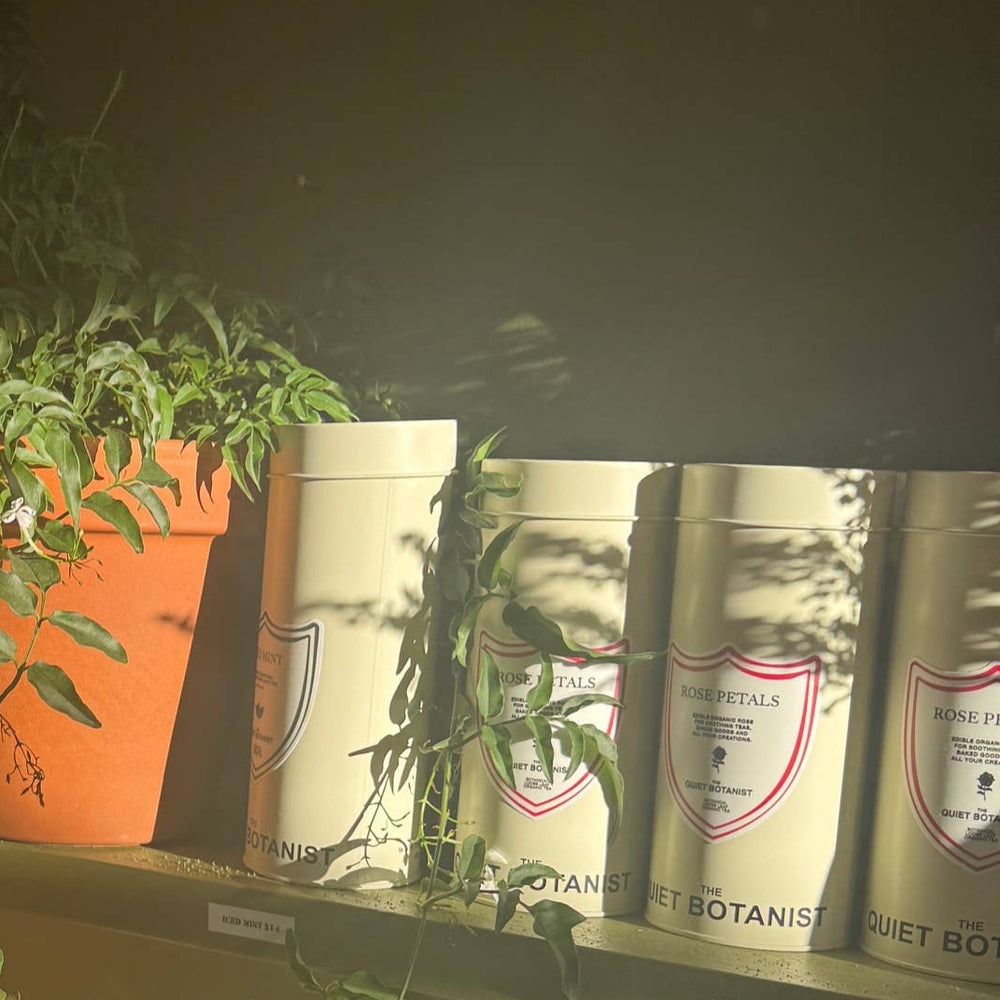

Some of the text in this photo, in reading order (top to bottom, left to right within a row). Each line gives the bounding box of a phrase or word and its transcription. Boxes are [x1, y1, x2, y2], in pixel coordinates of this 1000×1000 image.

[681, 684, 780, 708] ROSE PETALS
[934, 706, 979, 724] ROSE
[951, 736, 974, 744] EDIBLE
[685, 781, 753, 797] QUIET BOTANIST
[941, 808, 971, 820] QUIET
[531, 873, 632, 893] TANIST
[700, 885, 723, 897] THE
[650, 880, 827, 928] UIET BOTANIST
[868, 909, 933, 948] QUIET
[958, 919, 985, 932] THE
